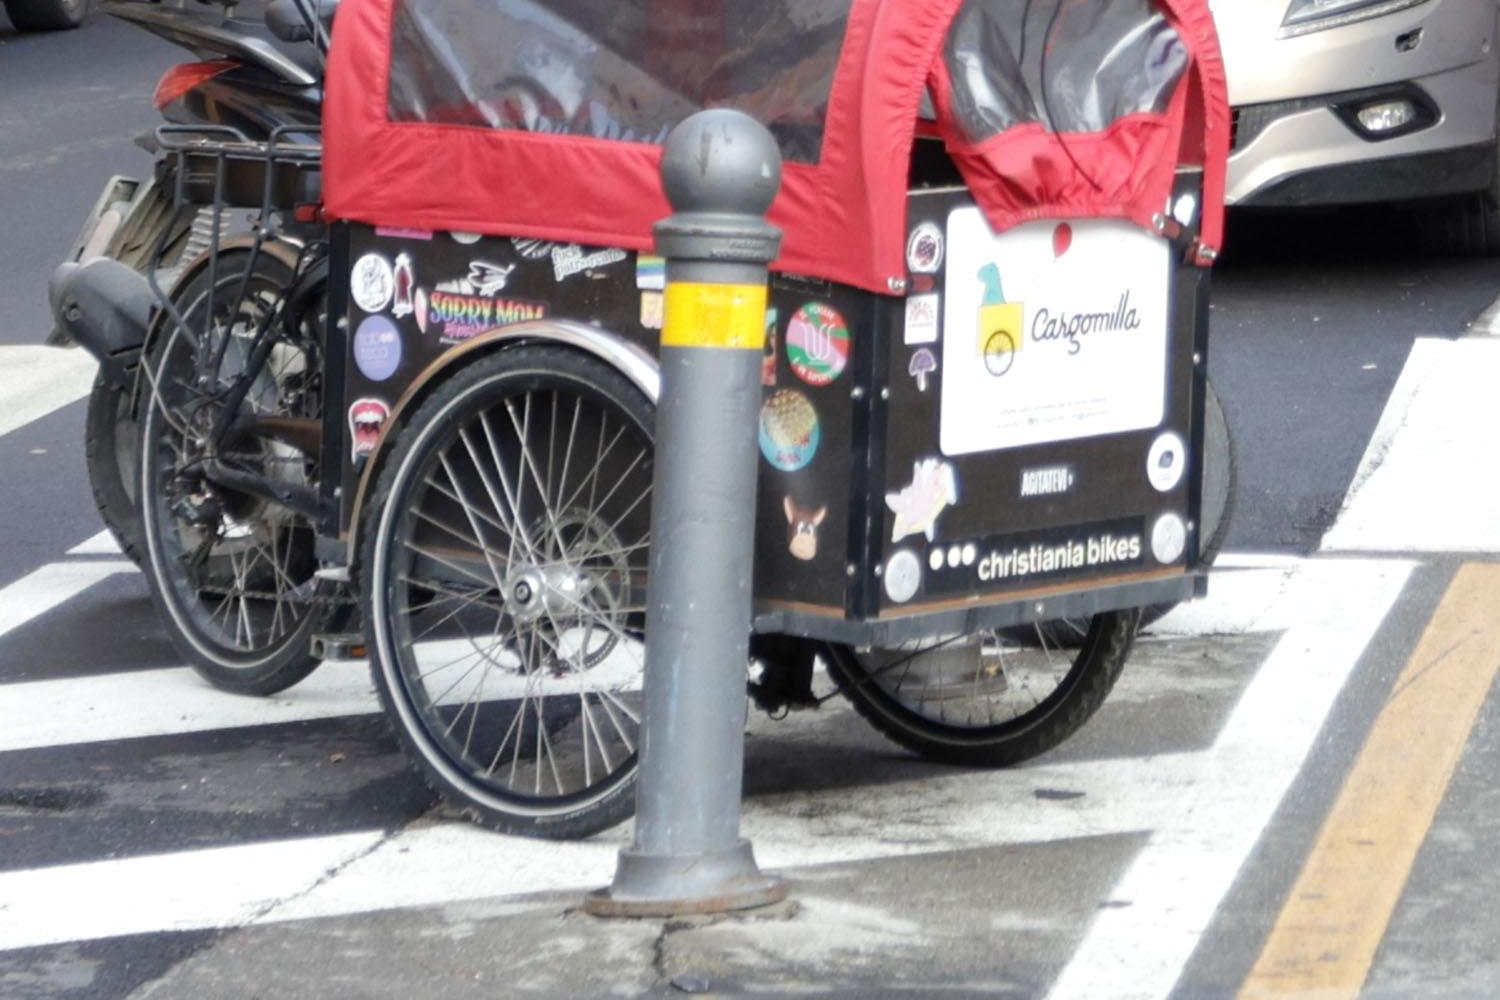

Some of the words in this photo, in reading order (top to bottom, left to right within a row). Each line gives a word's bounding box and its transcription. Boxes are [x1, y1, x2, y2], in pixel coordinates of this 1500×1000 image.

[430, 291, 492, 327] SORRY
[496, 298, 545, 326] MOM
[1031, 288, 1141, 356] Cargomilla
[977, 540, 1084, 581] christiania
[1087, 534, 1141, 566] bikes
